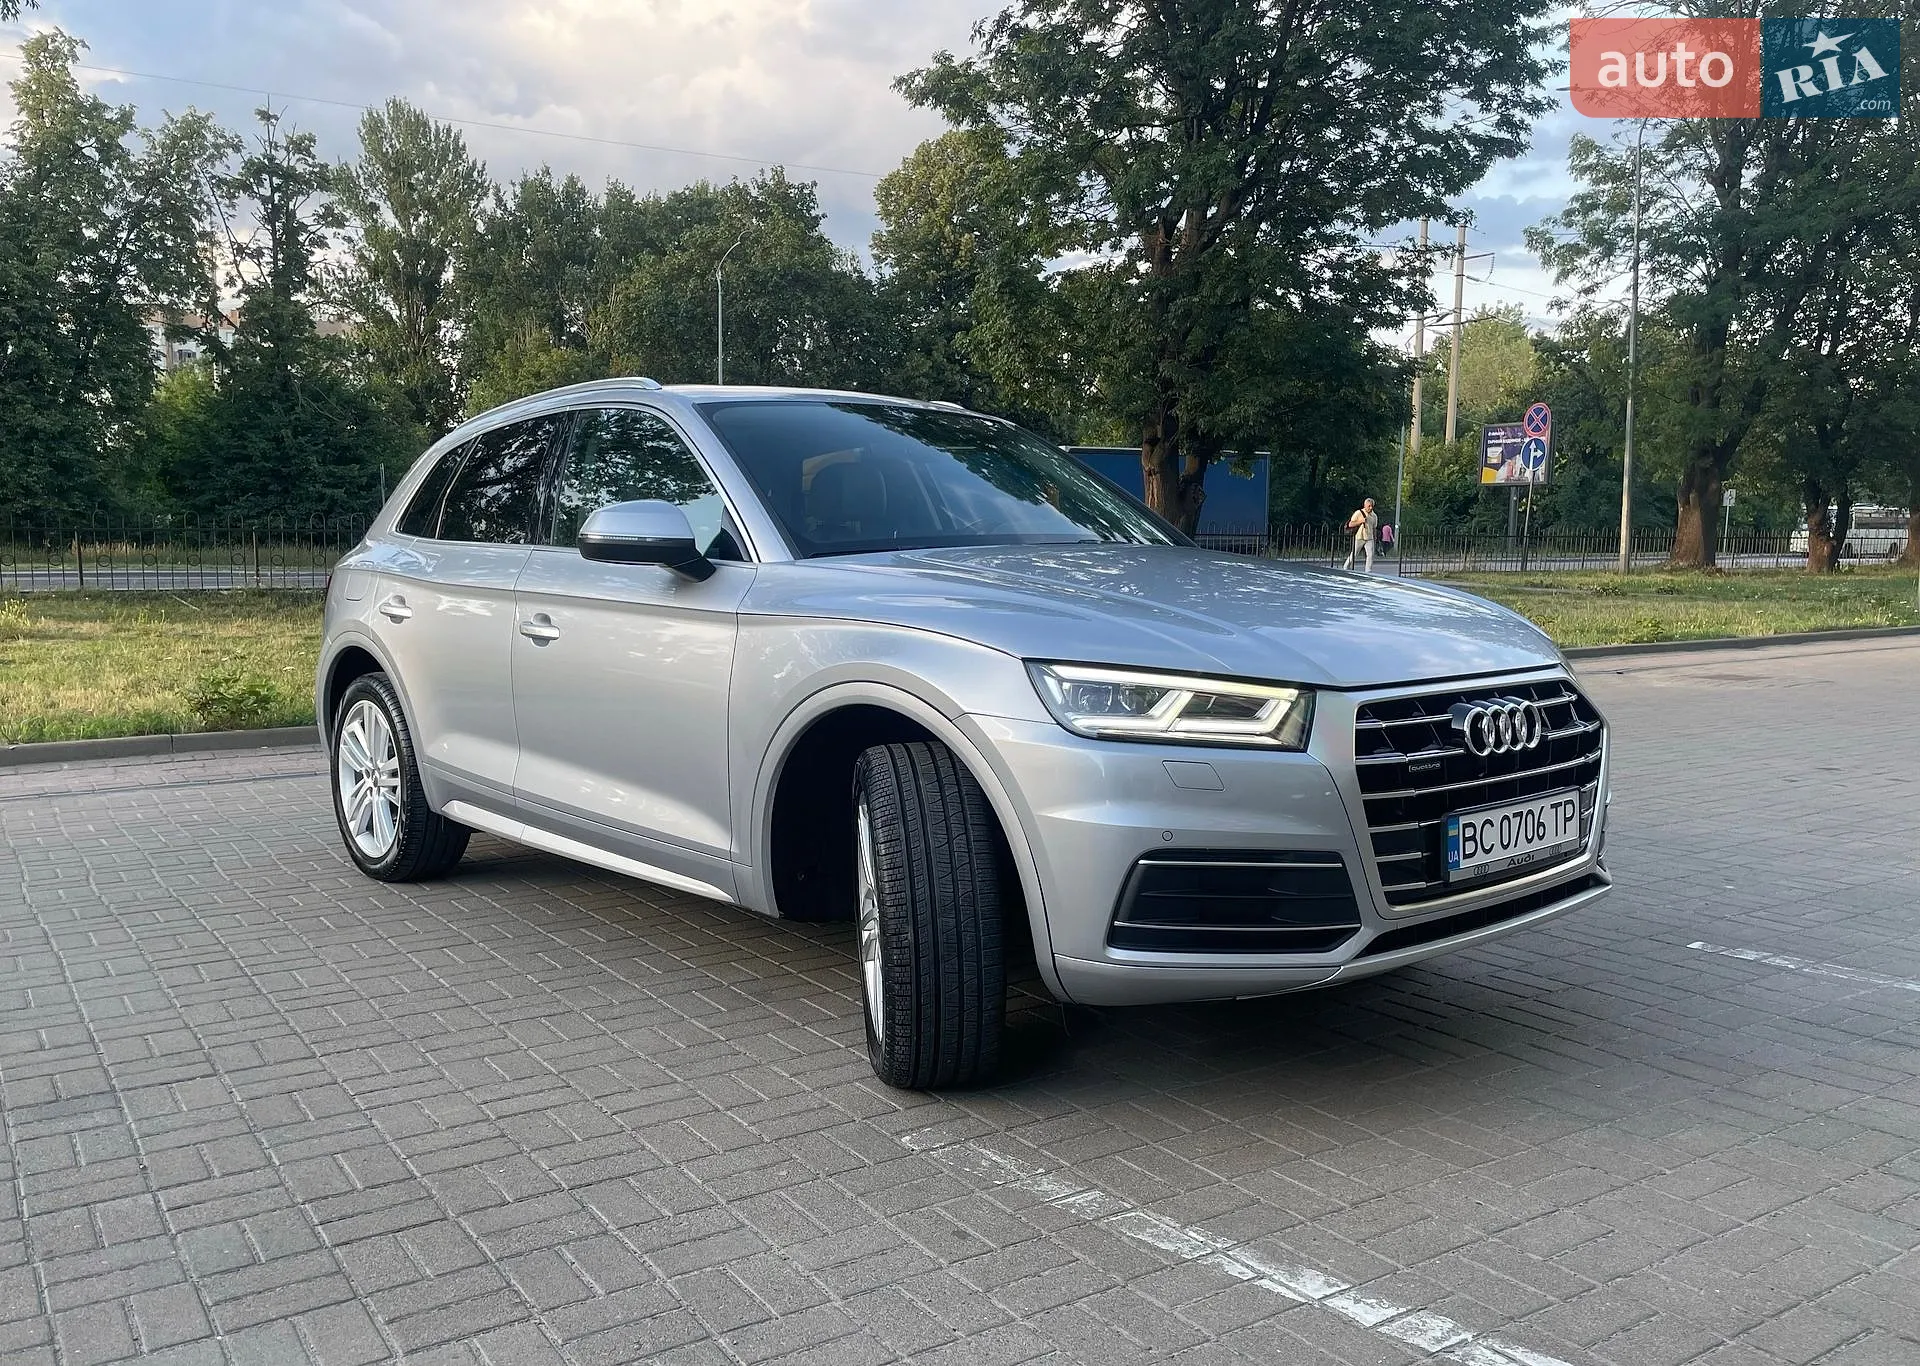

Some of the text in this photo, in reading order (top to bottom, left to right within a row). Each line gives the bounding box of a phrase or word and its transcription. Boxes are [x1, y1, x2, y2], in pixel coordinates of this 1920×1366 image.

[1462, 799, 1576, 860] BC 0706 TP
[1448, 850, 1459, 863] UA
[1507, 854, 1535, 867] Audi
